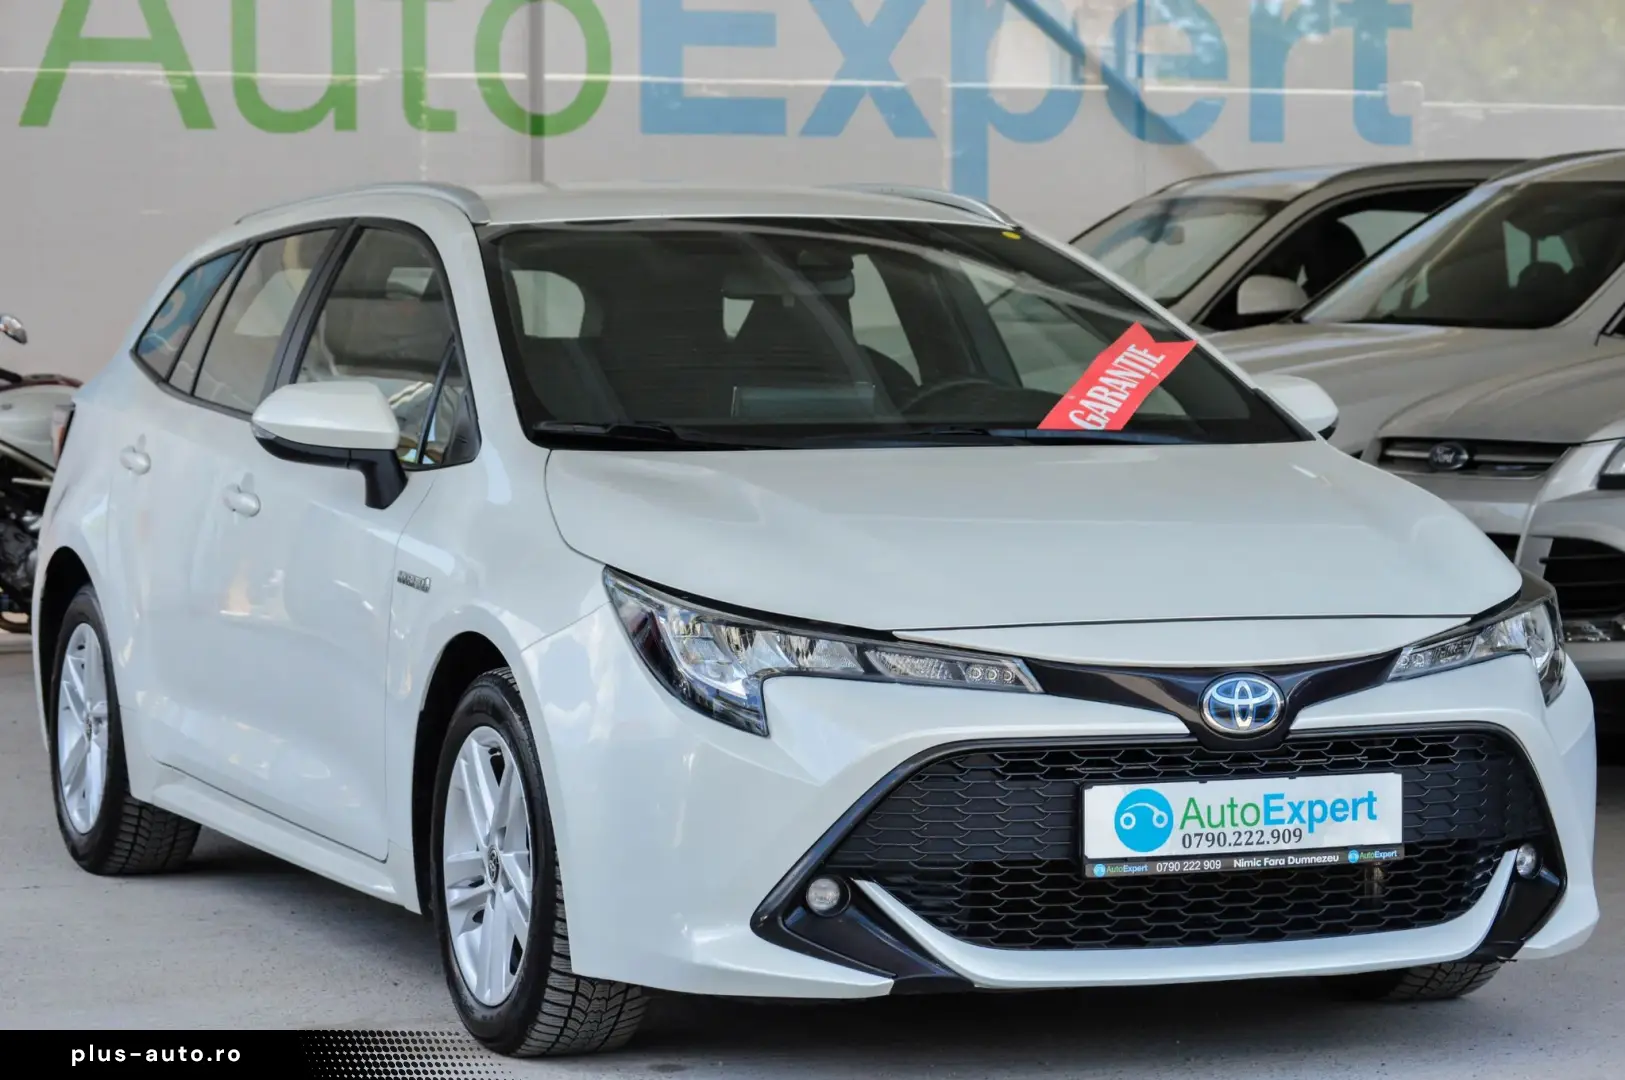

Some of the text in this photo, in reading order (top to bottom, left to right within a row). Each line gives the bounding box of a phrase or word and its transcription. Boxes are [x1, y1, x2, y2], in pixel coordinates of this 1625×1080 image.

[1179, 790, 1378, 833] AutoExpert
[1182, 828, 1303, 849] 0790.222.909
[1106, 850, 1398, 874] AutoExpert 0790 222 909 Nimic Fara Dumnezeu AutoExpert
